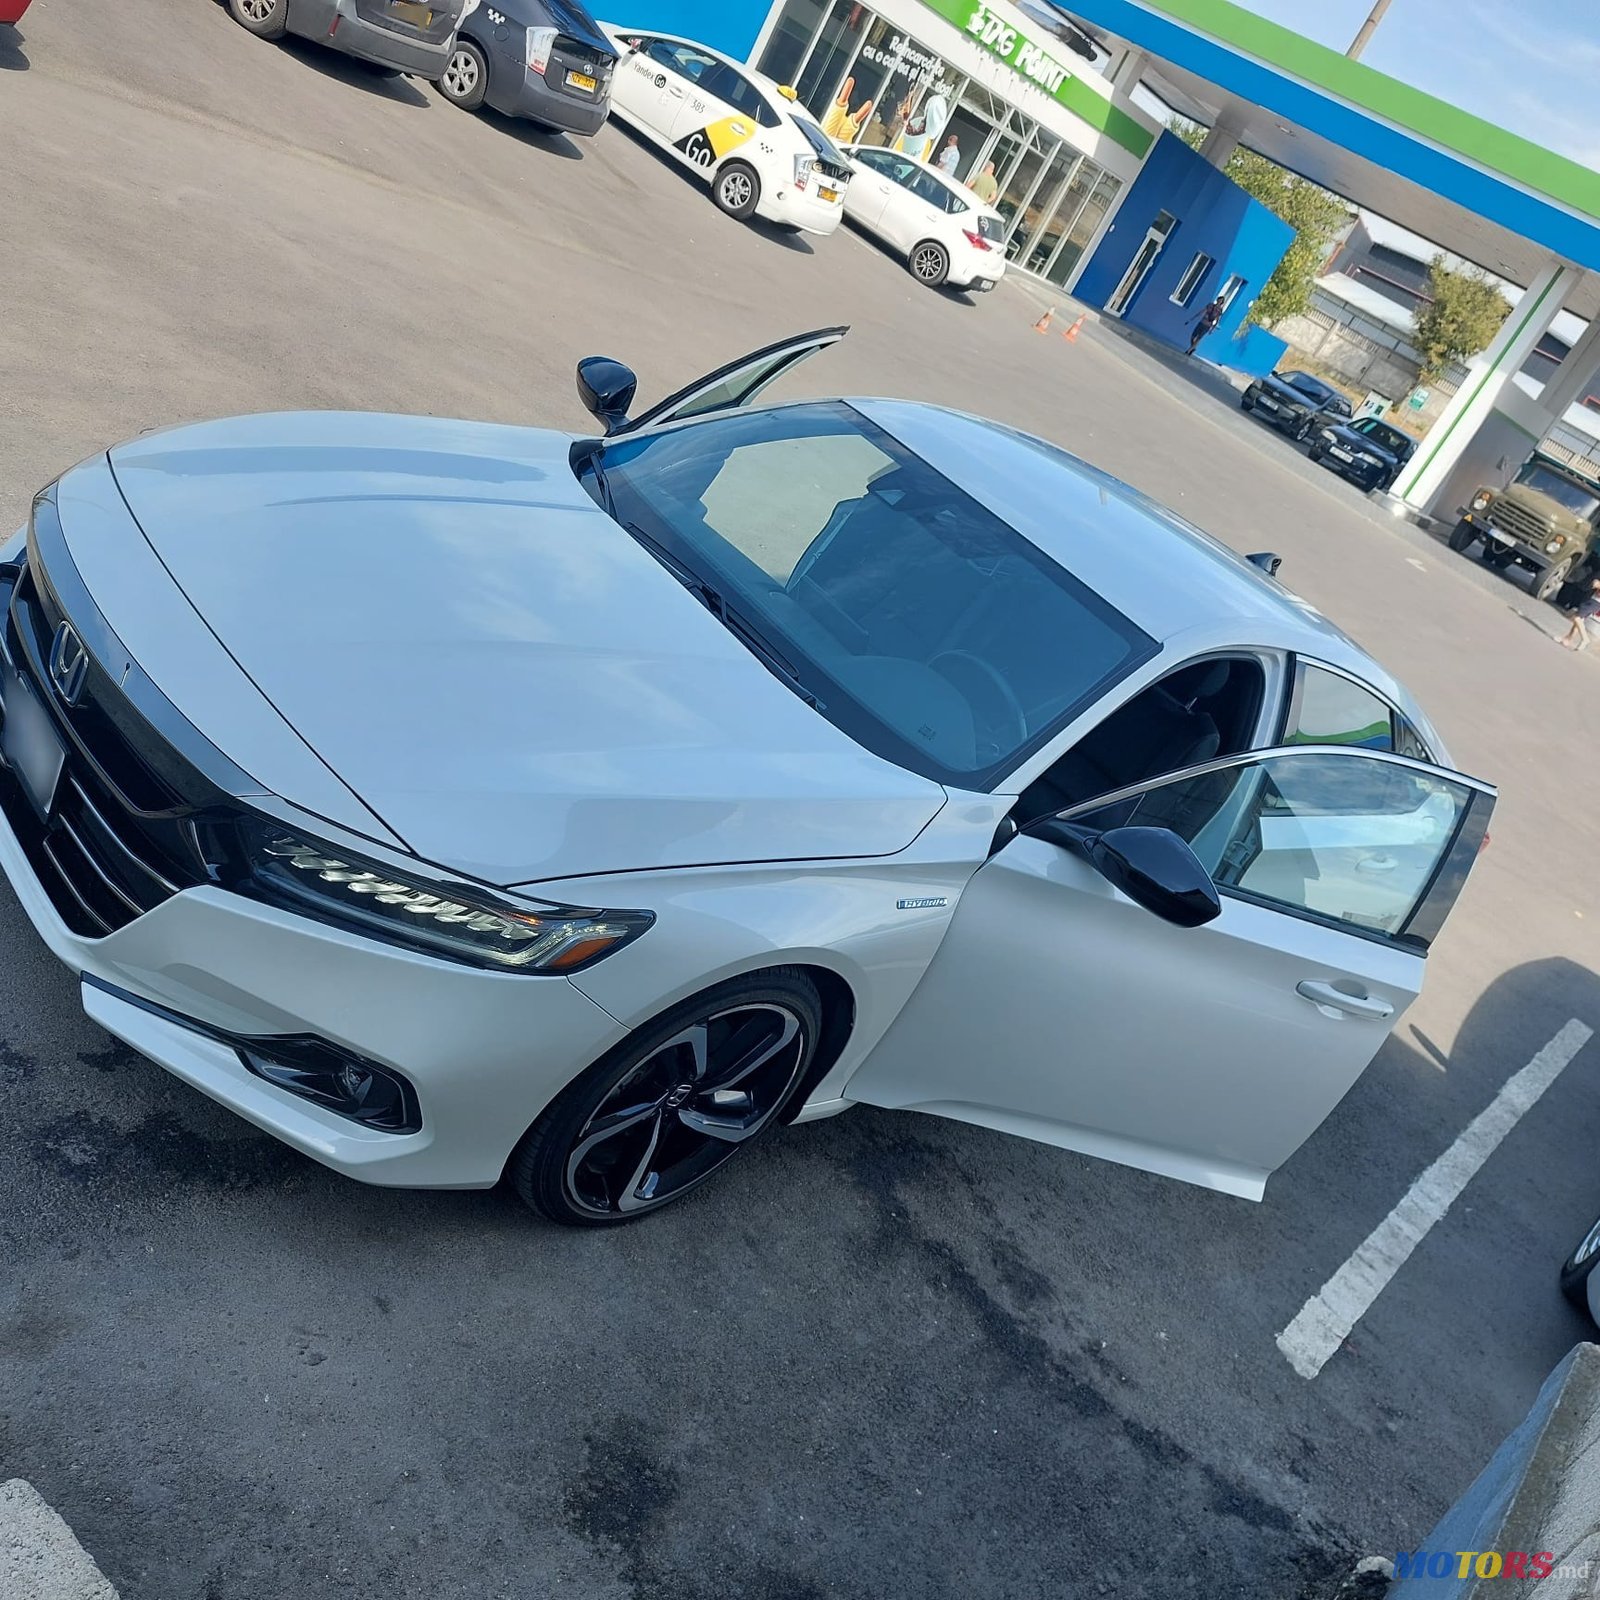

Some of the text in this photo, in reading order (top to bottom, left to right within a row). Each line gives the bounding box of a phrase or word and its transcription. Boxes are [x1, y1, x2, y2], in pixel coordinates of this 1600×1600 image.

[862, 45, 877, 60] cu
[875, 51, 884, 63] o
[882, 53, 911, 76] cafea
[1015, 41, 1073, 94] POINT
[633, 62, 666, 88] Yandex Go
[690, 99, 706, 114] 383
[685, 132, 712, 168] Go
[903, 898, 948, 908] HYBRID
